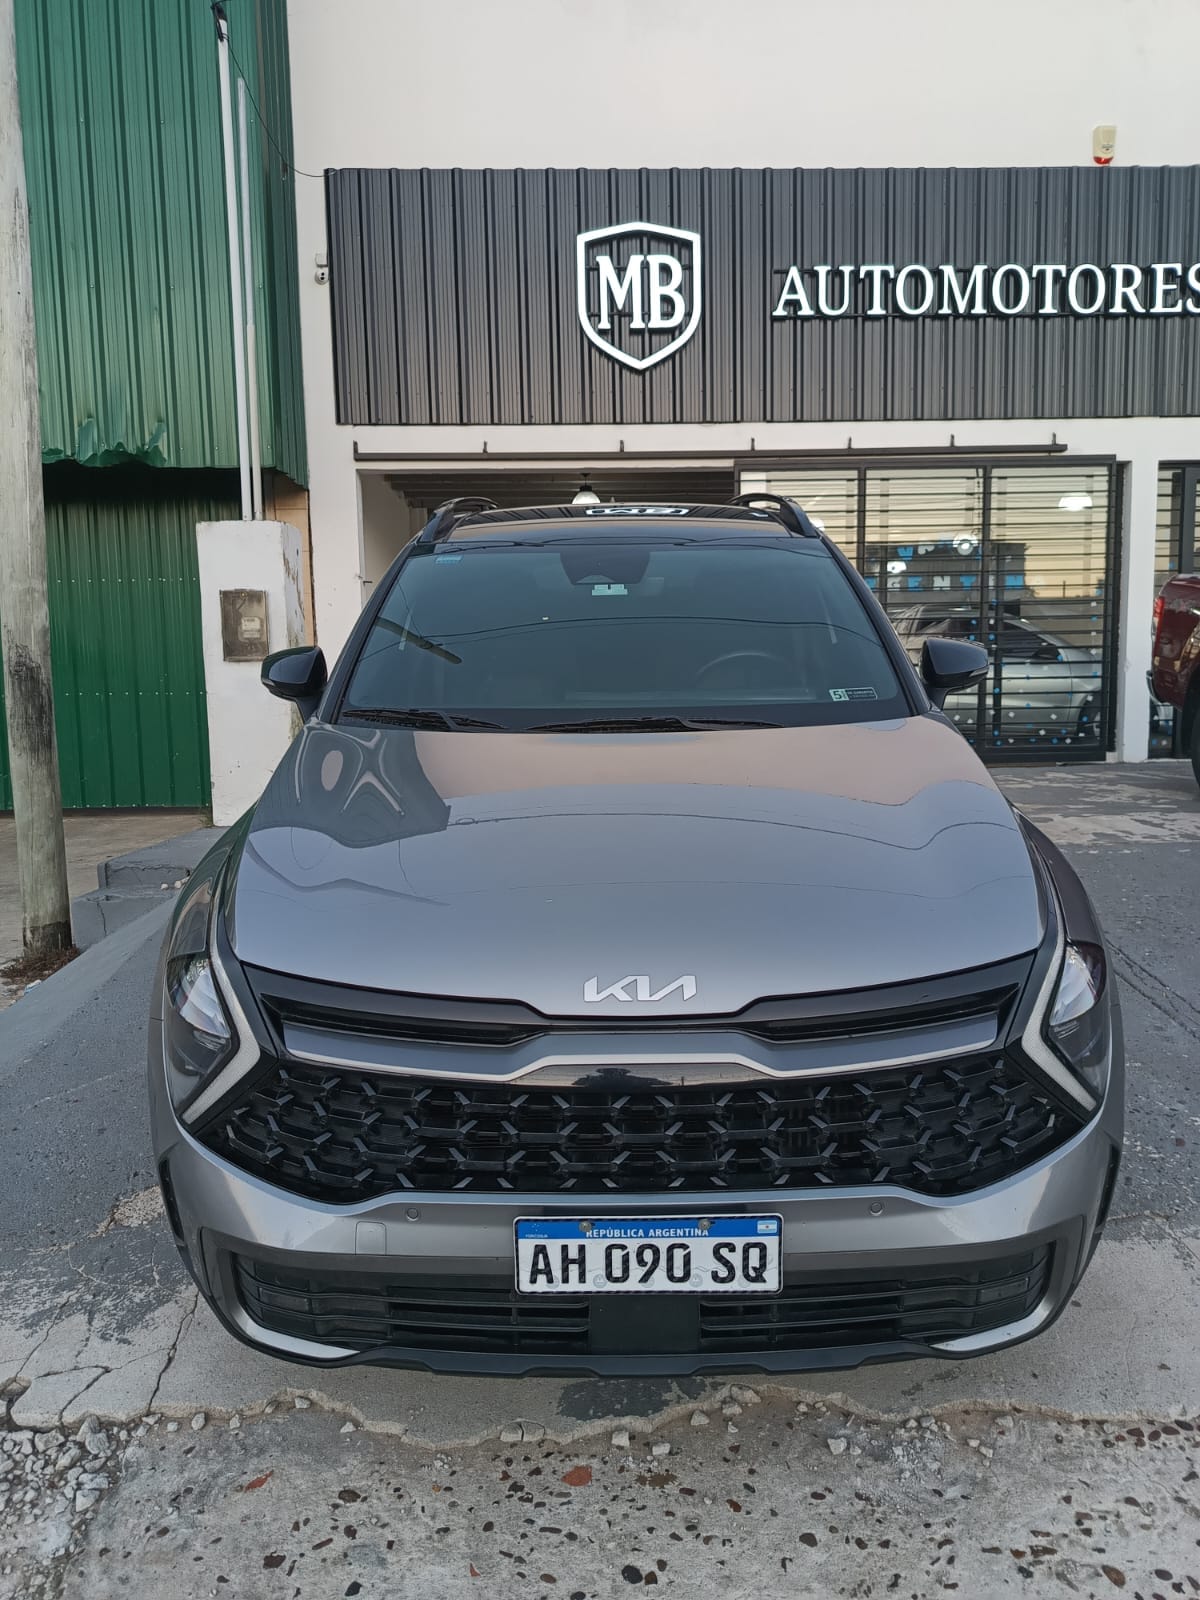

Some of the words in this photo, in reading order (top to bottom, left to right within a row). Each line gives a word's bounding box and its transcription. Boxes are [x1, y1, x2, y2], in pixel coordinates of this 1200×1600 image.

[596, 254, 685, 331] MB
[583, 975, 697, 1002] KIA
[586, 1226, 644, 1238] REPÚBLICA
[648, 1227, 709, 1237] ARGENTINA
[529, 1244, 586, 1284] AH
[605, 1243, 691, 1283] 090
[711, 1242, 767, 1283] SQ
